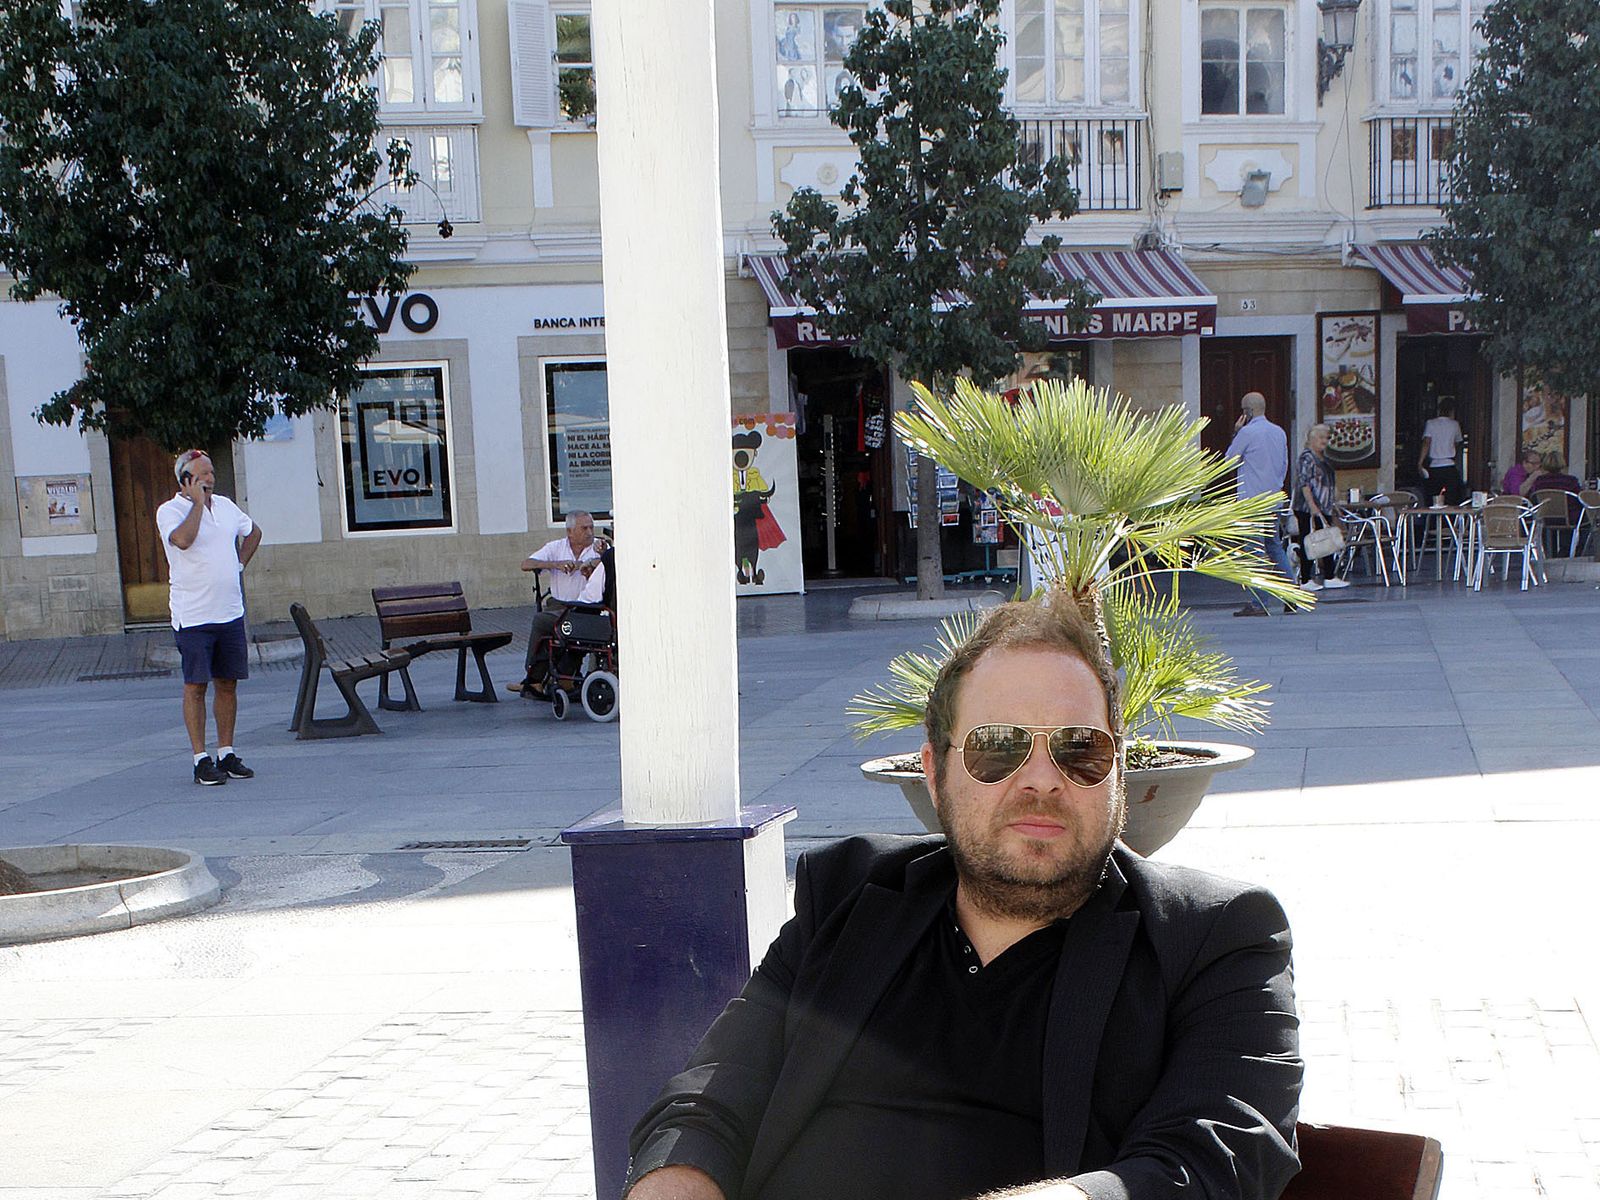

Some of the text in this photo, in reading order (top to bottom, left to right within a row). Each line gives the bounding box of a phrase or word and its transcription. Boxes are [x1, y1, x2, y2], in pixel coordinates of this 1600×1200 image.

[534, 317, 576, 329] BANCA
[1112, 311, 1198, 333] MARPE
[373, 468, 420, 487] EVO
